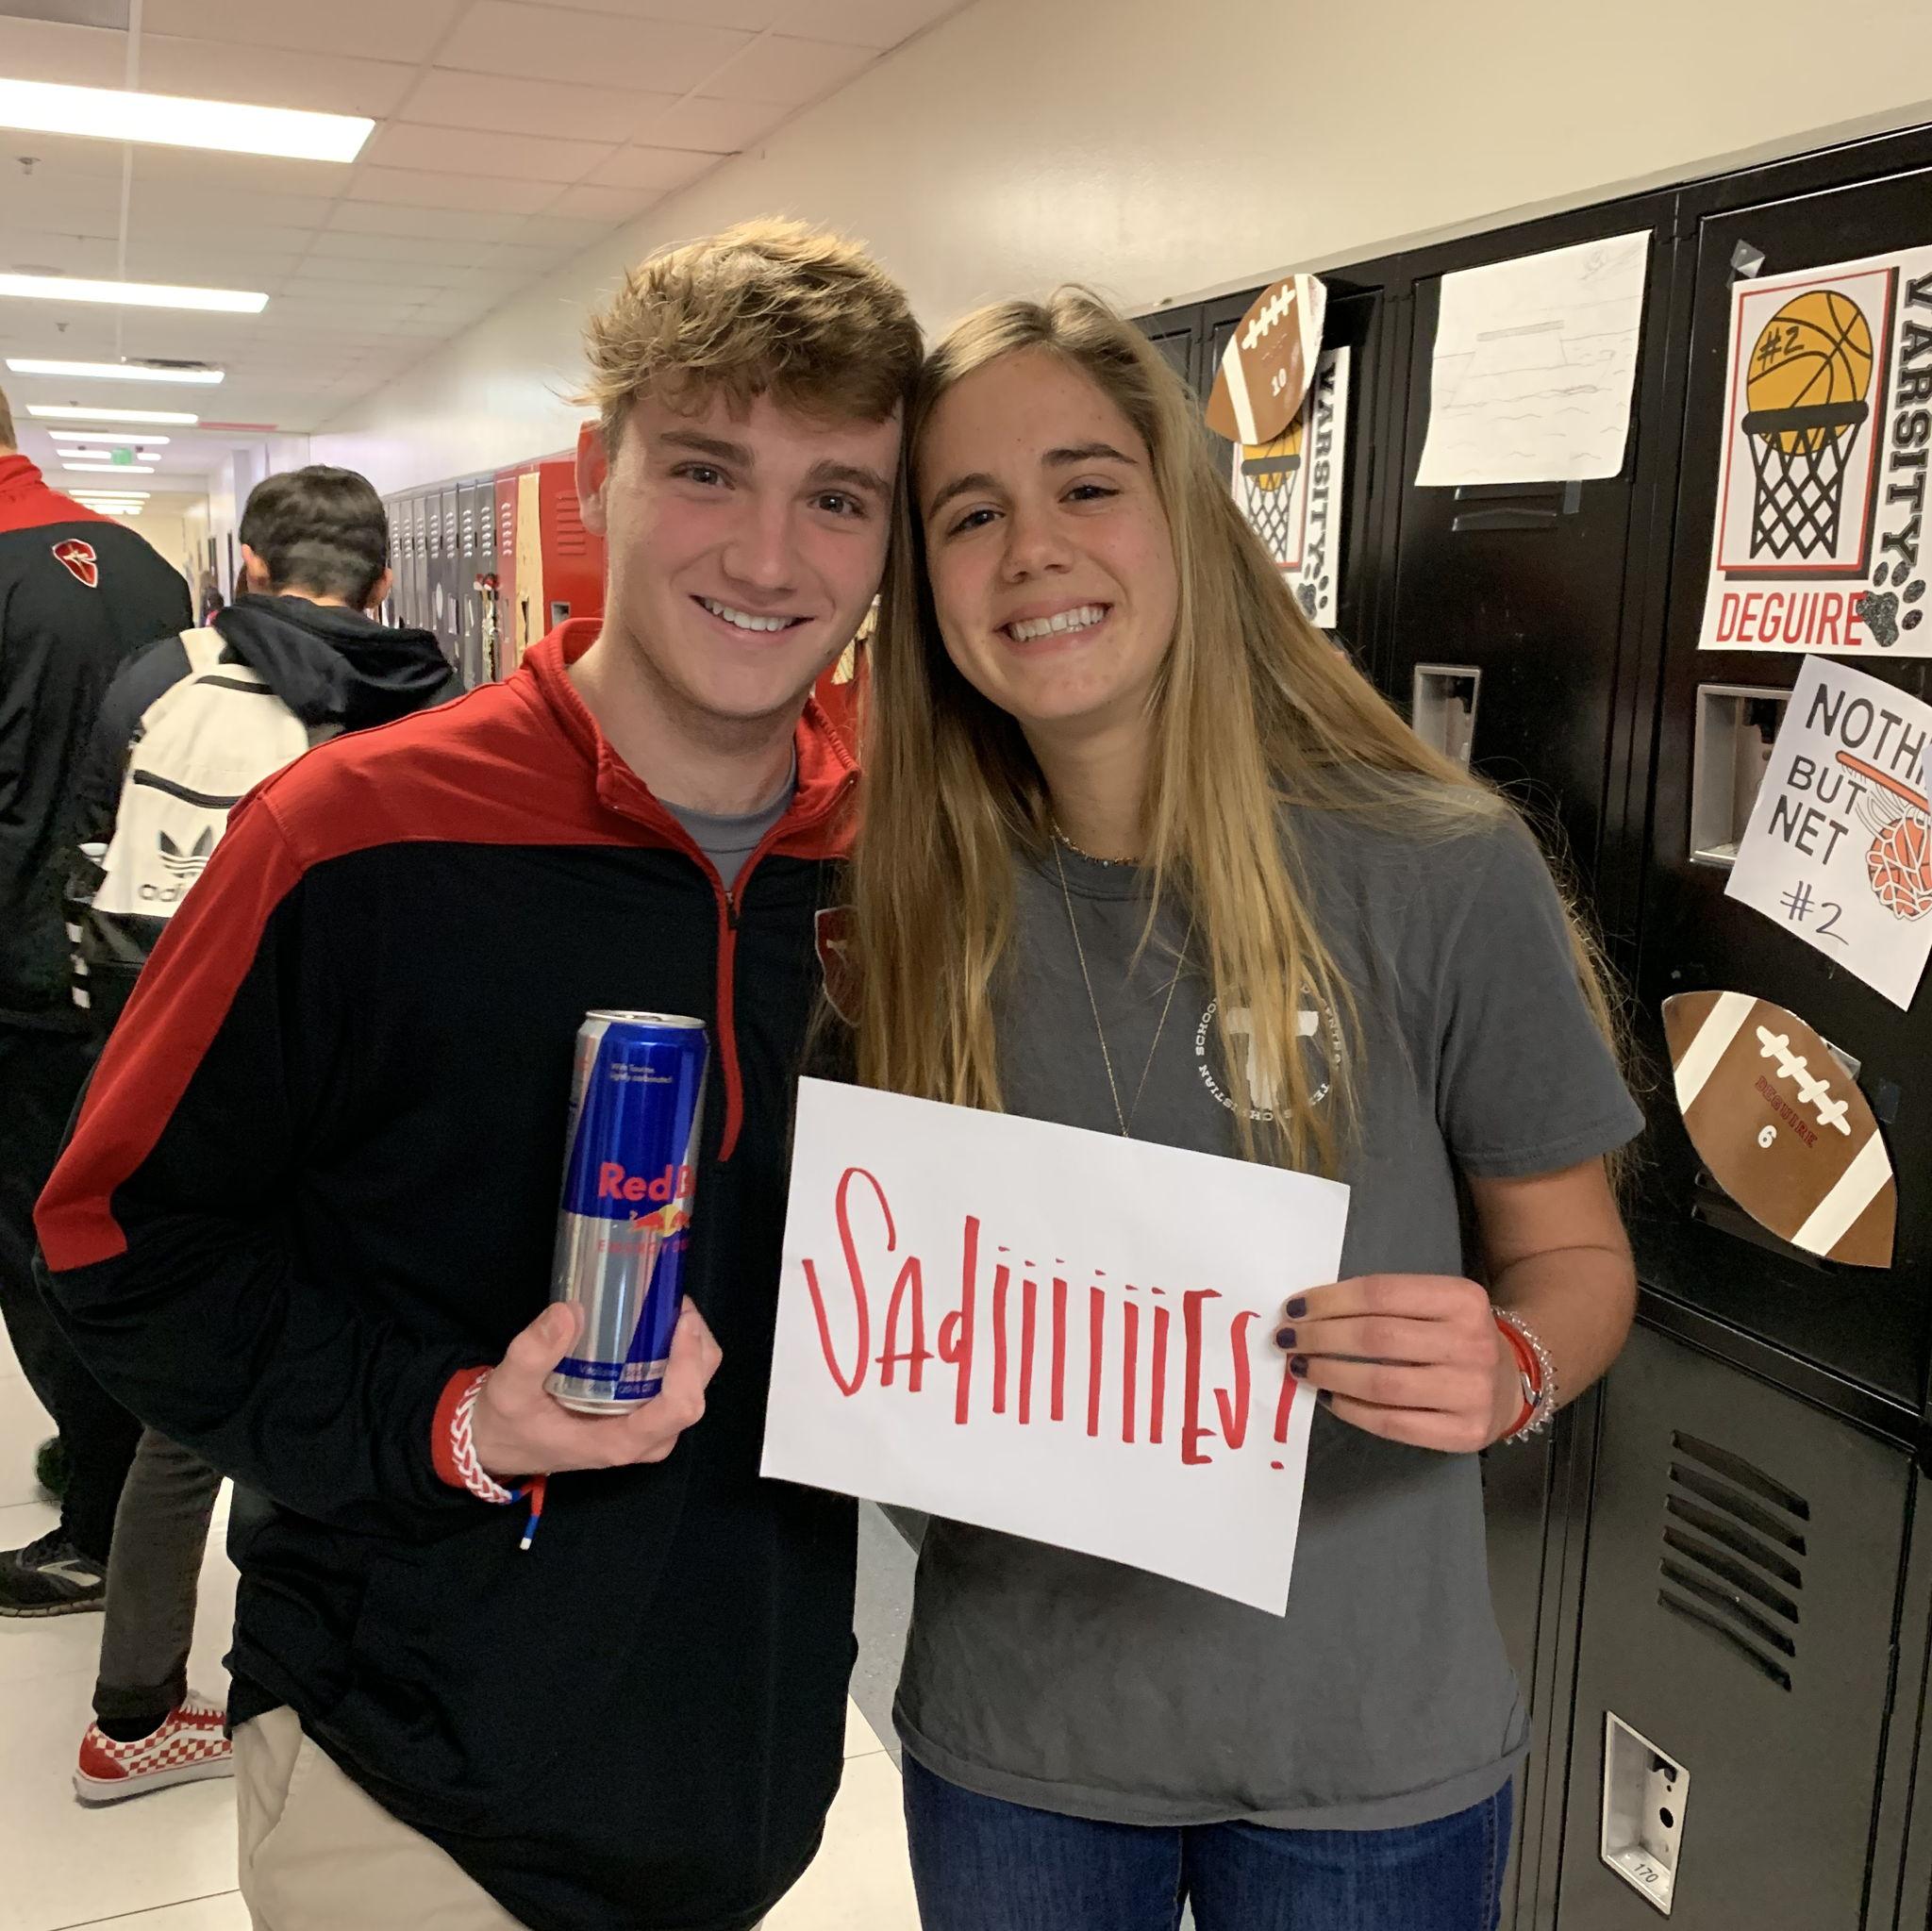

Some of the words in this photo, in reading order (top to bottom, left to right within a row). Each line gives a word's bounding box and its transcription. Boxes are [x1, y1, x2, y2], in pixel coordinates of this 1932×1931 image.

[1757, 325, 1805, 372] #2
[1271, 368, 1287, 397] 10
[1880, 271, 1932, 566] VARSITY
[1307, 362, 1337, 567] VARSITY
[1716, 591, 1867, 646] DEGUIRE
[1787, 755, 1867, 815] BUT
[1768, 794, 1849, 865] NET
[1780, 880, 1849, 945] #2
[1195, 997, 1218, 1056] SCHOO
[1756, 1075, 1818, 1148] DEGUIRE
[1757, 1124, 1777, 1148] 6
[598, 1161, 674, 1202] Red
[1634, 1863, 1658, 1883] 170
